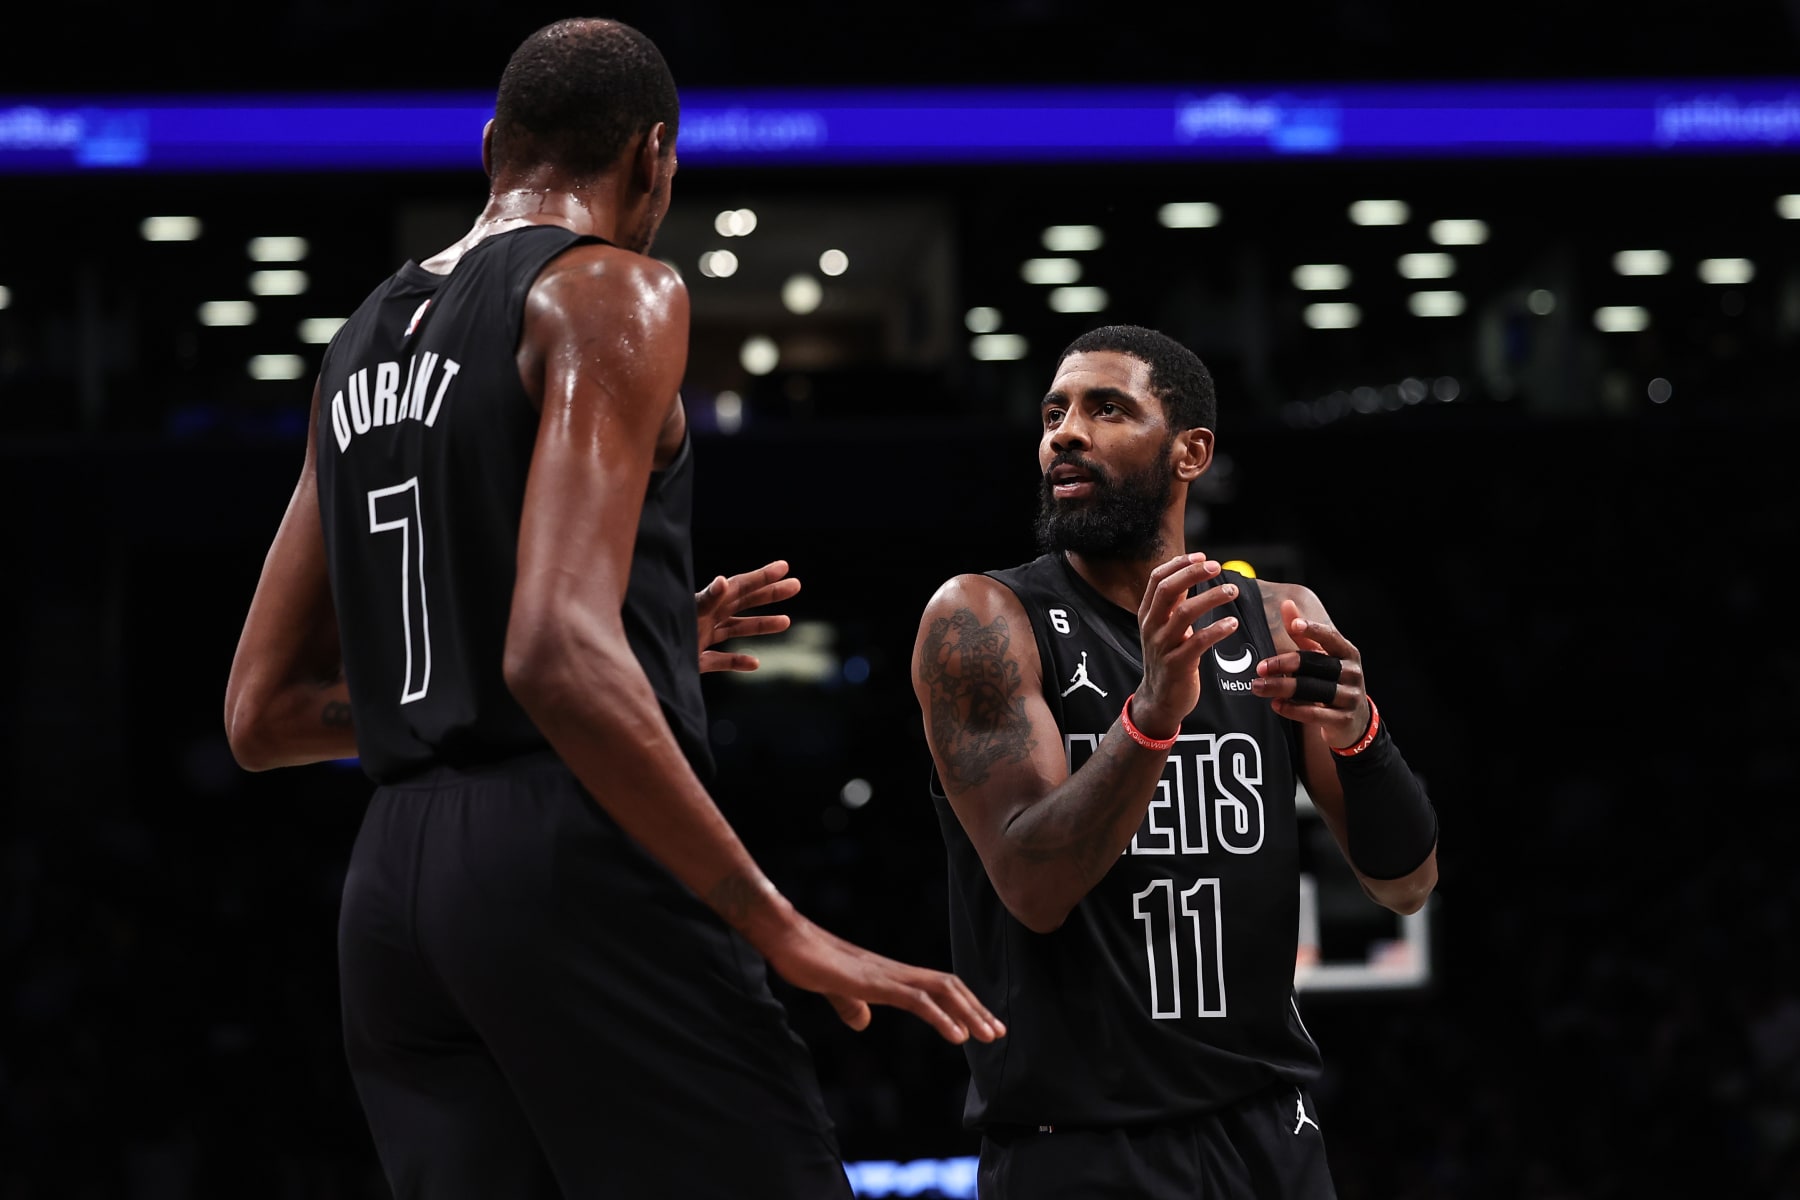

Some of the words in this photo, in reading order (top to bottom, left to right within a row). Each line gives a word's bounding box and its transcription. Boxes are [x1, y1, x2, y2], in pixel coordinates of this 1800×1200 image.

[332, 351, 460, 453] DURANT
[368, 476, 431, 704] 7
[1049, 608, 1071, 634] 6
[1220, 678, 1254, 691] Webu
[1132, 877, 1227, 1019] 11
